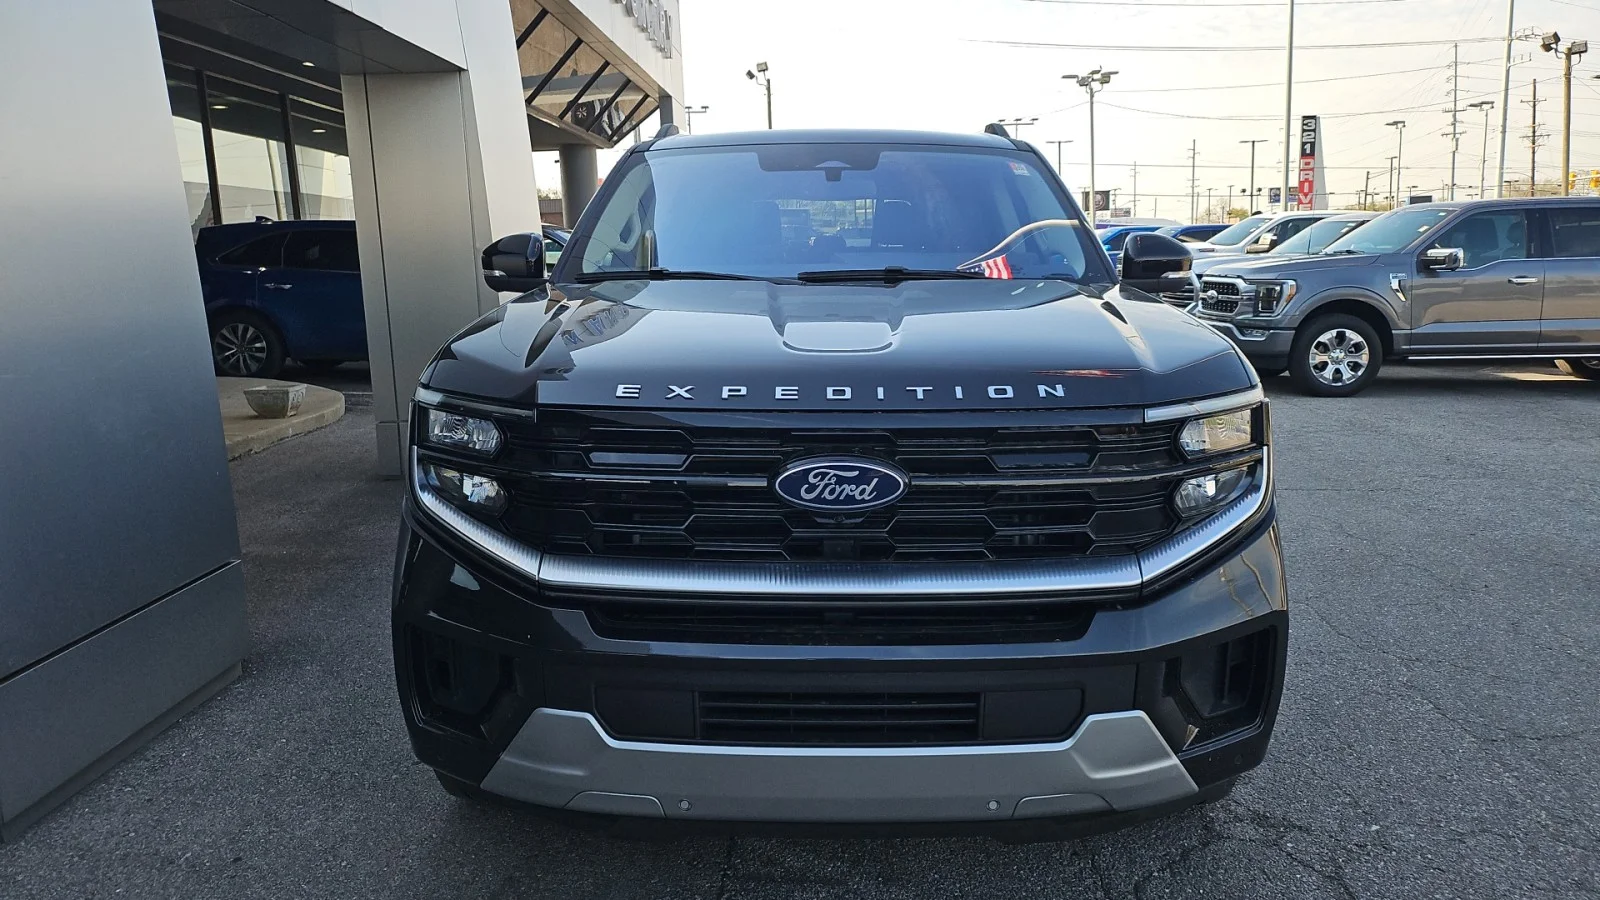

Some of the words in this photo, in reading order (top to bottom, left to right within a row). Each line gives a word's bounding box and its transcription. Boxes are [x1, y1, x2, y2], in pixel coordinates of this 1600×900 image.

[1302, 119, 1316, 154] 321
[615, 383, 1065, 400] EXPEDITION
[800, 468, 879, 501] Ford
